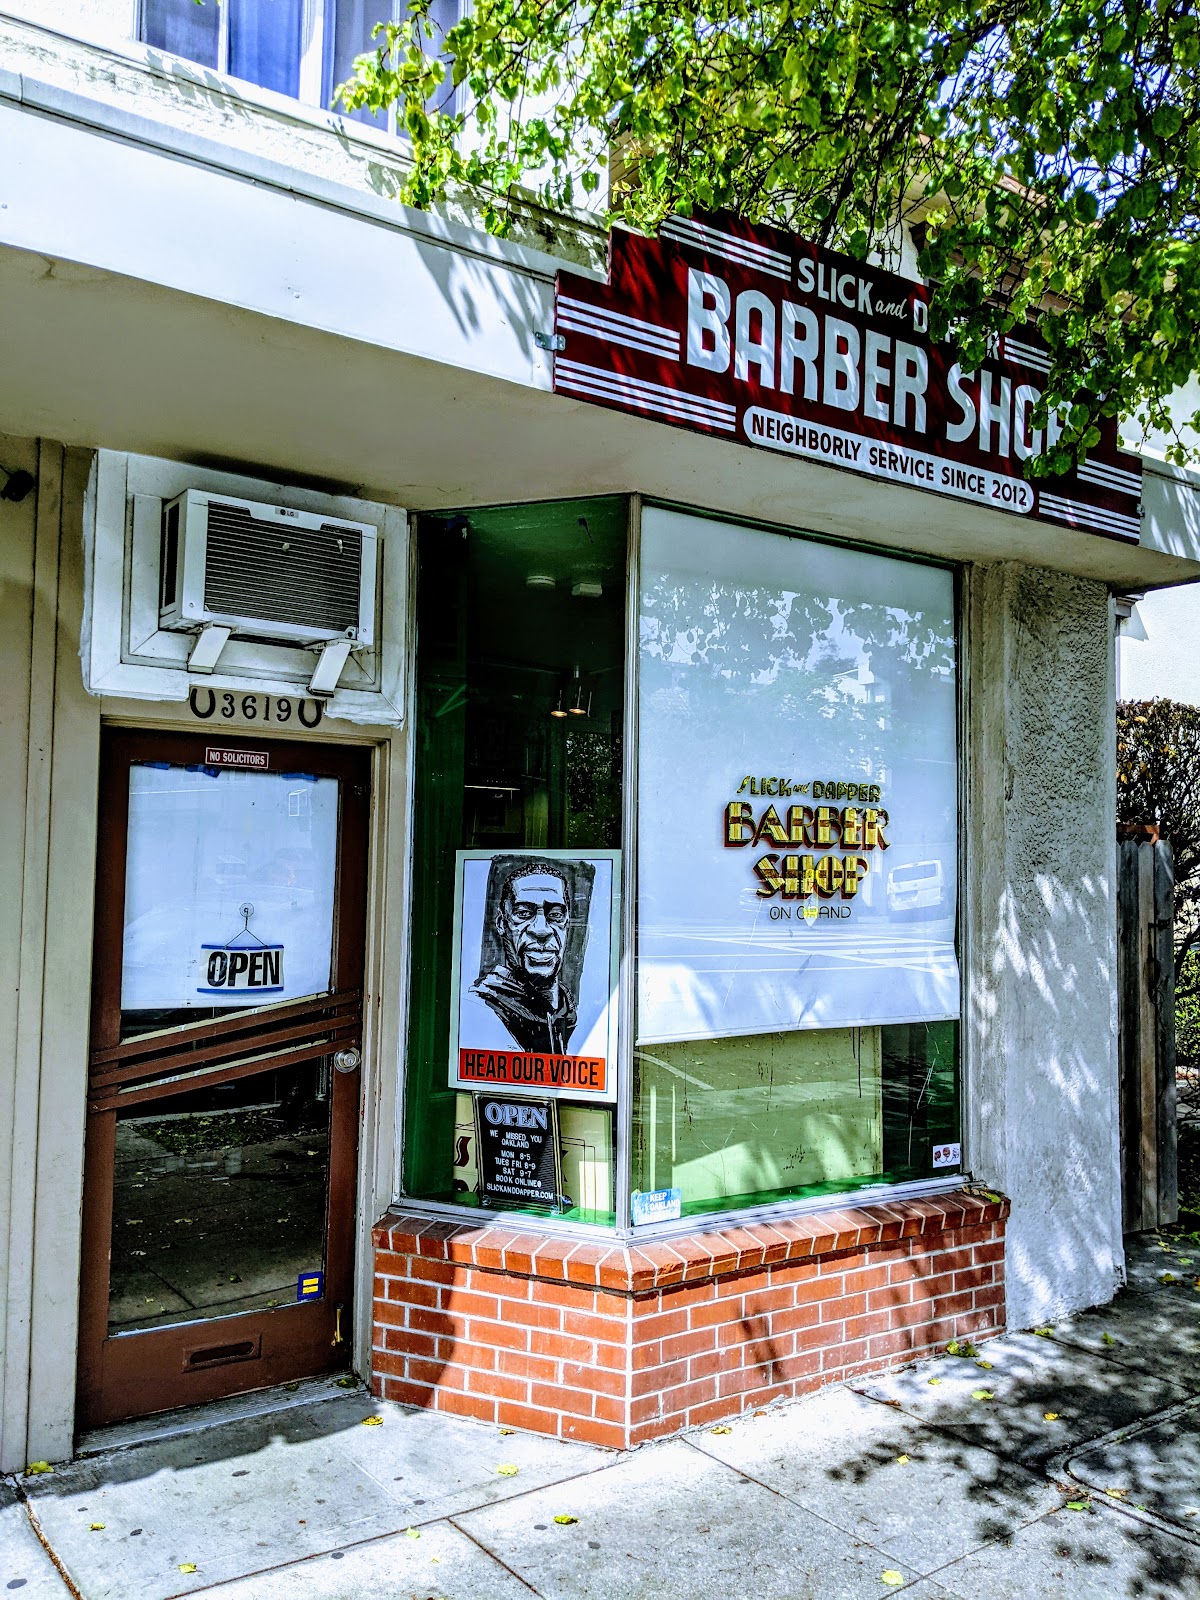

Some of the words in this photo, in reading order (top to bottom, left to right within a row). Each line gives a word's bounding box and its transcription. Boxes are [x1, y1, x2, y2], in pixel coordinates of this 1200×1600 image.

[797, 258, 874, 316] SLICK
[875, 298, 908, 320] and
[686, 266, 929, 434] BARBER
[751, 413, 862, 462] NEIGHBORLY
[869, 446, 934, 482] SERVICE
[941, 466, 986, 495] SINCE
[991, 480, 1028, 507] 2012
[209, 751, 221, 762] NO
[222, 752, 265, 766] SOLICITORS
[736, 775, 793, 797] SLICK
[813, 780, 881, 802] DAPPER
[724, 801, 891, 850] BARBER
[752, 853, 870, 900] SHOP
[769, 905, 792, 921] ON
[207, 951, 280, 987] OPEN
[465, 1053, 507, 1079] HEAR
[512, 1056, 545, 1082] OUR
[550, 1058, 599, 1086] VOICE
[485, 1102, 548, 1130] OPEN
[490, 1129, 499, 1138] WE
[505, 1132, 527, 1141] MISSED
[530, 1134, 543, 1144] YOU
[501, 1138, 530, 1149] OAKLAND
[494, 1156, 510, 1167] TUES
[511, 1160, 522, 1169] FRI
[524, 1161, 536, 1171] 8-9
[501, 1150, 515, 1159] MON
[519, 1152, 531, 1161] 8-5
[495, 1174, 514, 1184] BOOK
[502, 1167, 515, 1176] SAT
[519, 1169, 532, 1178] 9-7
[486, 1182, 554, 1200] SLICKANDDAPPER.COM
[649, 1192, 668, 1203] KEEP
[649, 1198, 681, 1212] OAKLAND
